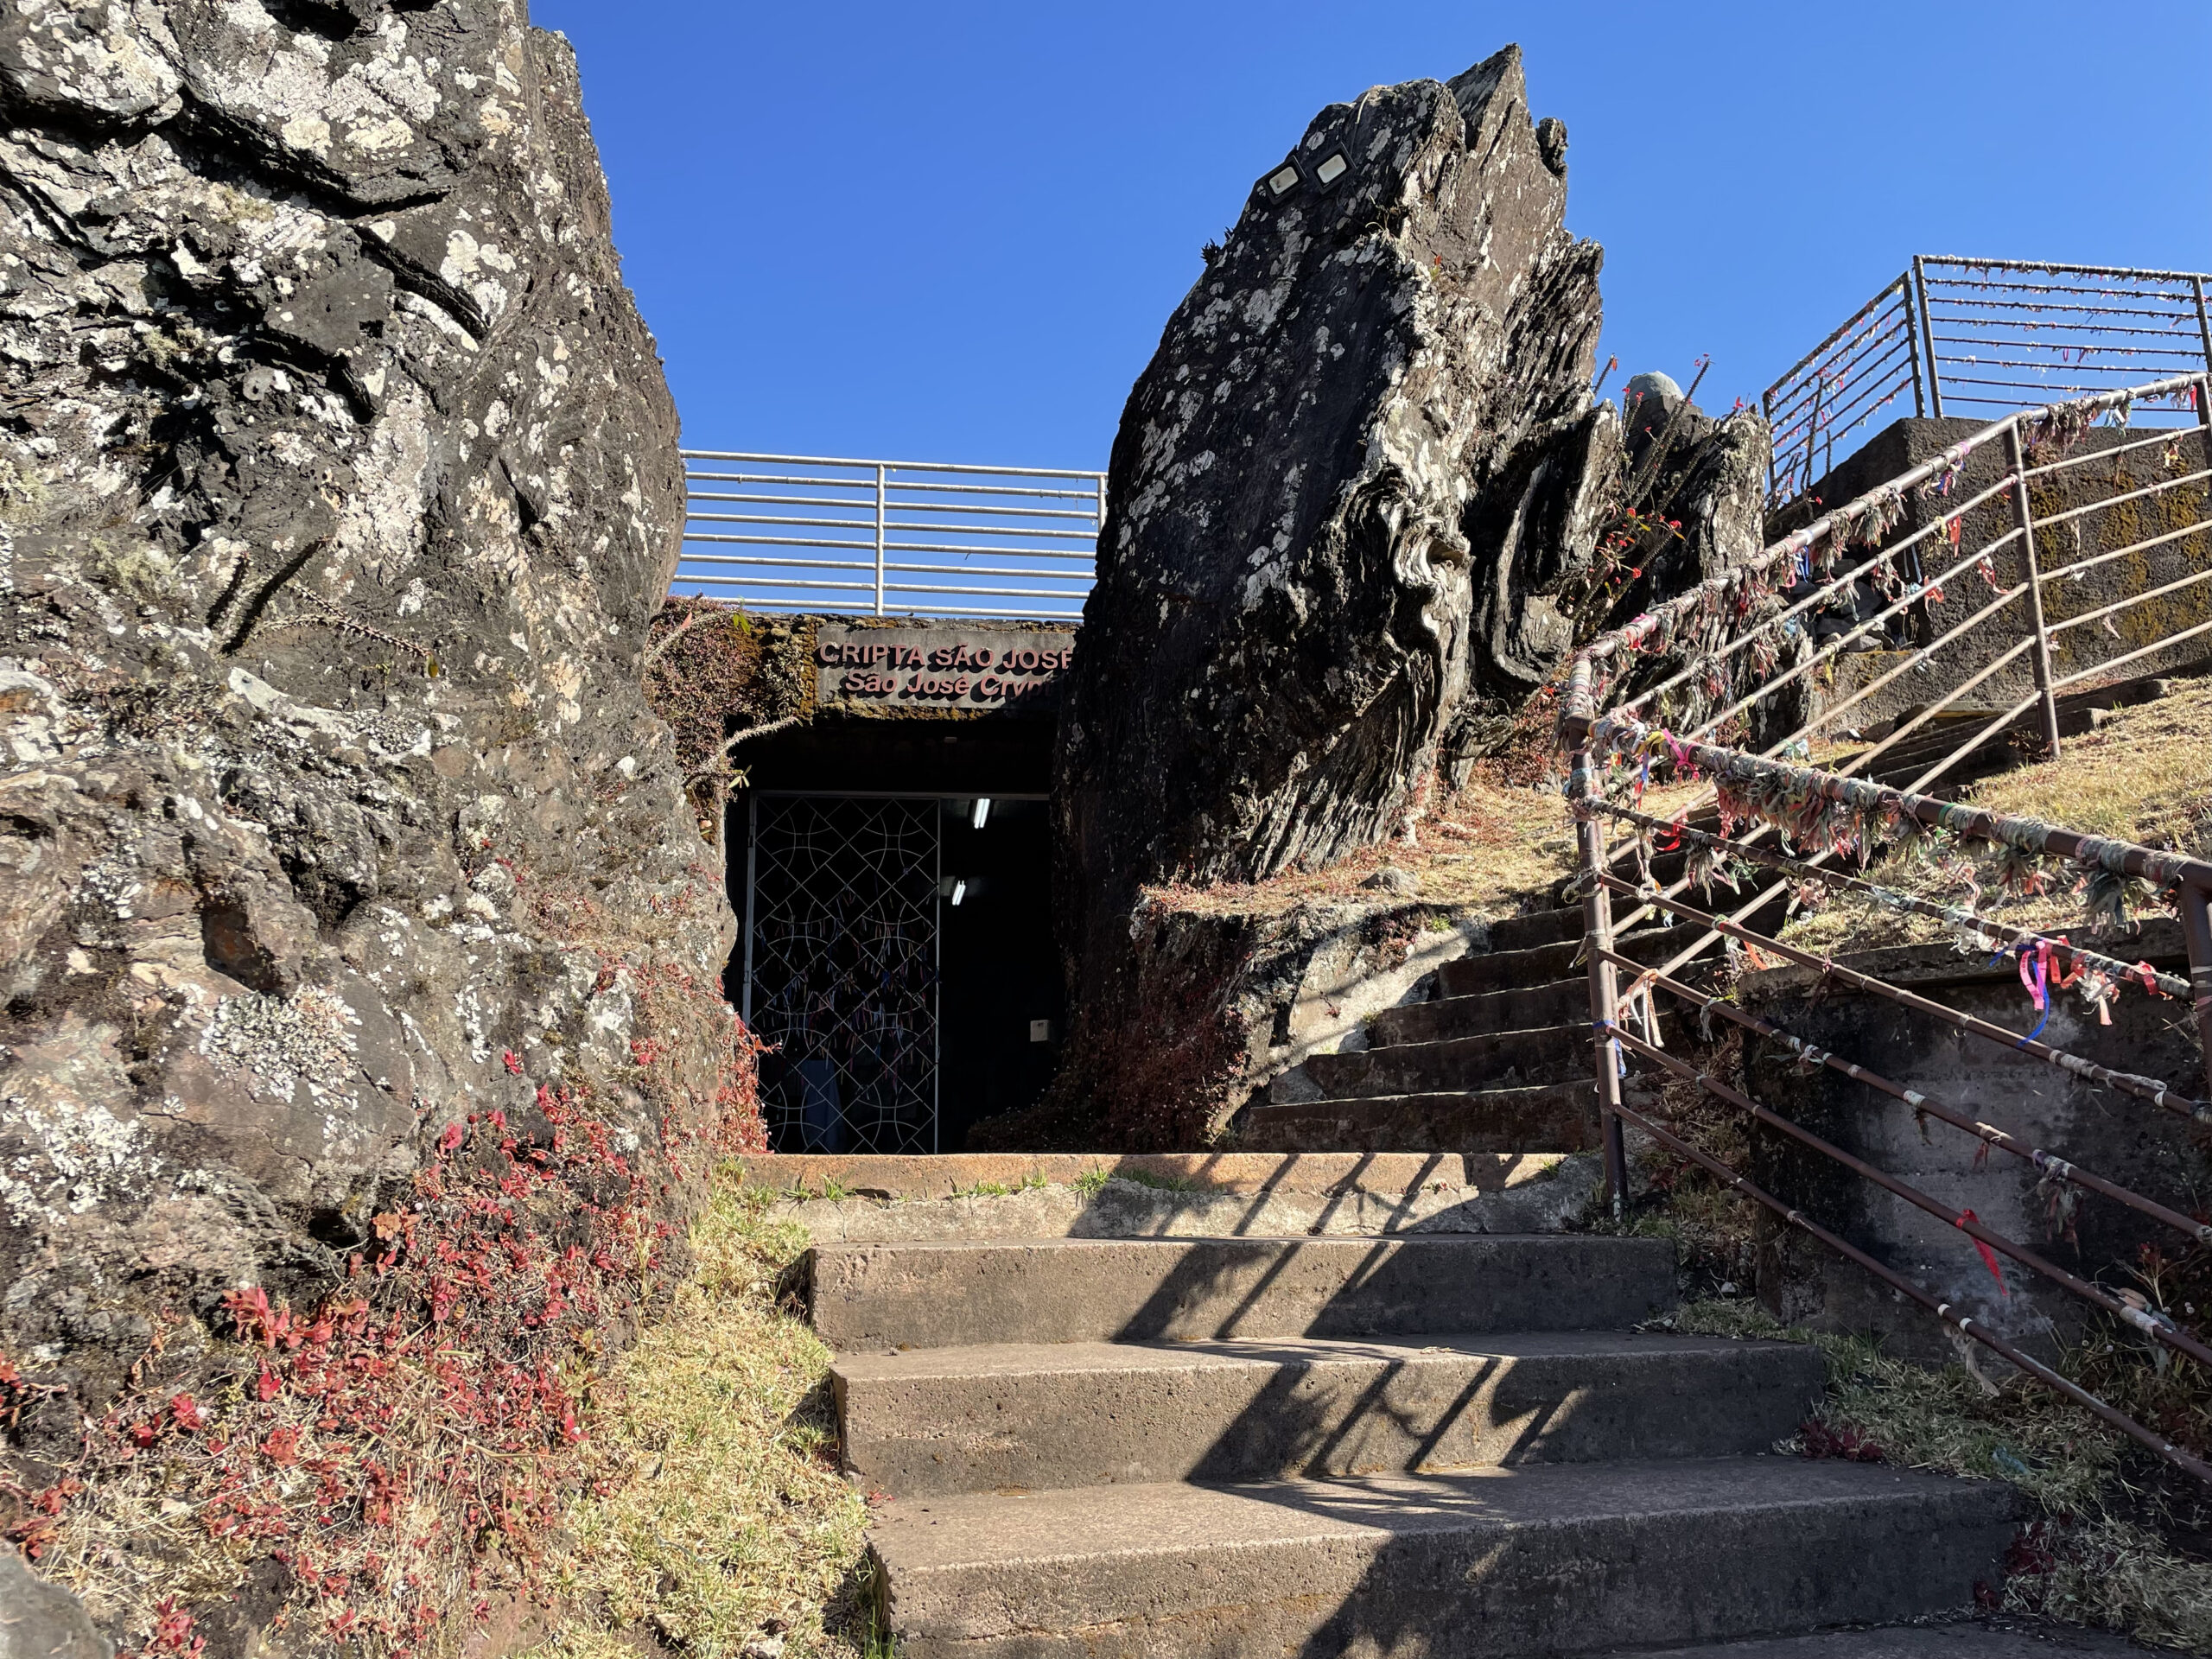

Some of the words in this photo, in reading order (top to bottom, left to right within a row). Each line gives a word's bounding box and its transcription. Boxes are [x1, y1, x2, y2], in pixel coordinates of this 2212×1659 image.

[819, 641, 925, 665] CRIPTA
[935, 642, 995, 667] SÃO
[845, 668, 898, 692] São
[906, 672, 969, 695] José
